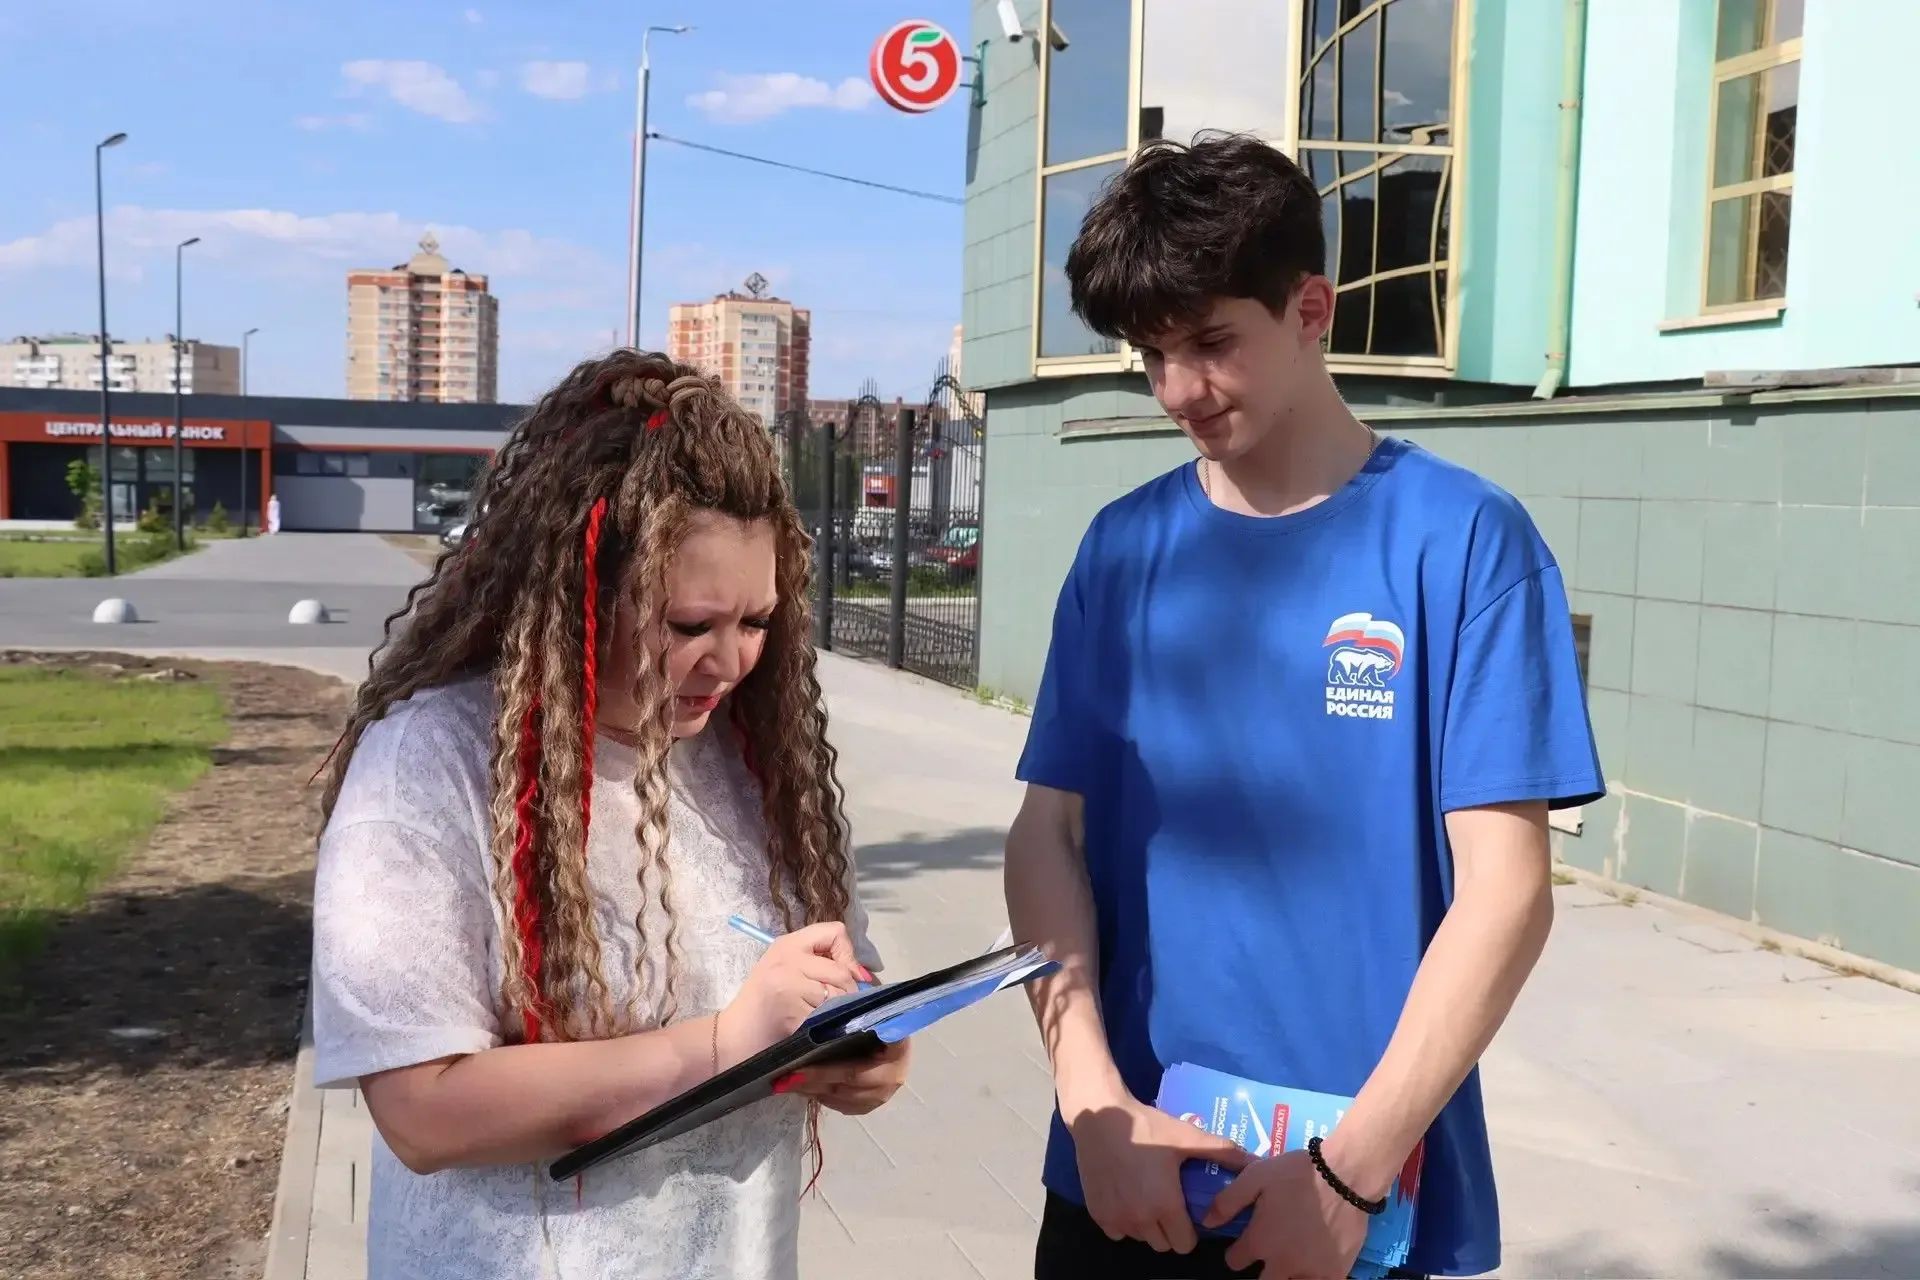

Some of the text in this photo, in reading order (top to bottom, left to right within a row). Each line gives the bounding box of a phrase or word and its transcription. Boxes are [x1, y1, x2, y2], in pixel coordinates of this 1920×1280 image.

[899, 28, 945, 93] 5
[166, 425, 225, 440] РЫНОК
[1326, 687, 1394, 704] ЕДИНАЯ
[1326, 701, 1393, 719] РОССИЯ
[1273, 1108, 1285, 1157] ЕЗУЛЬТАТ!
